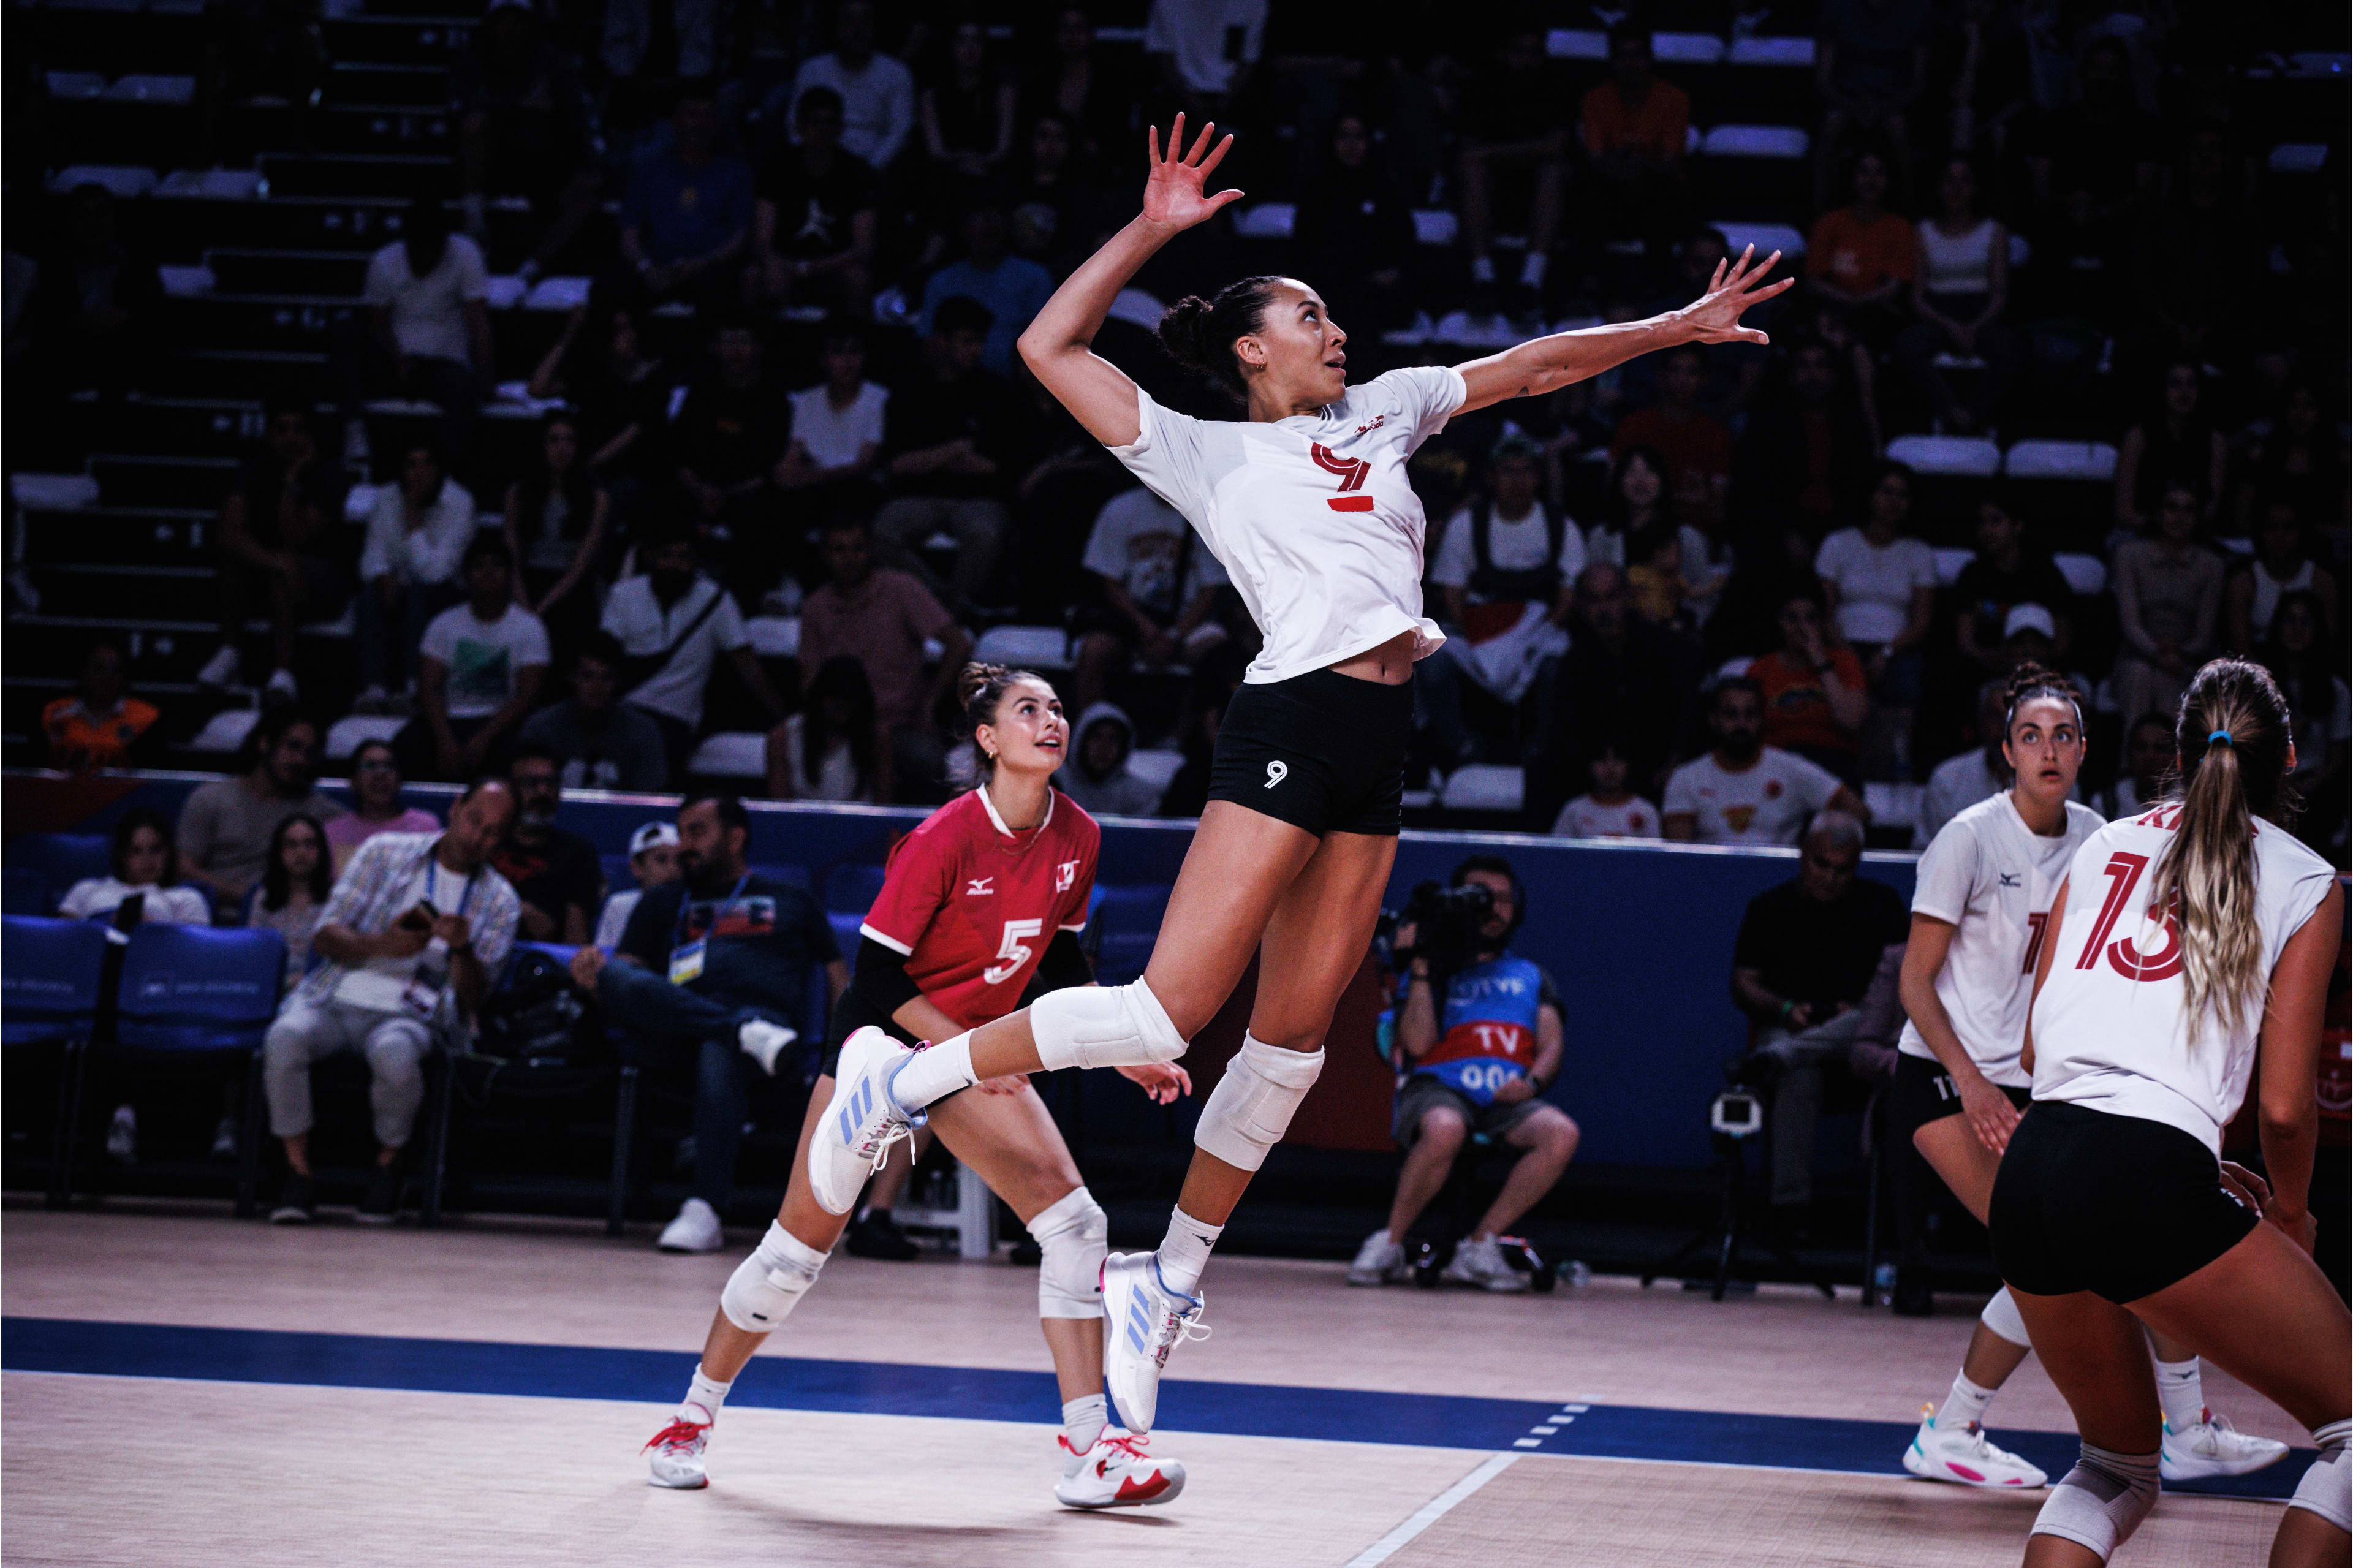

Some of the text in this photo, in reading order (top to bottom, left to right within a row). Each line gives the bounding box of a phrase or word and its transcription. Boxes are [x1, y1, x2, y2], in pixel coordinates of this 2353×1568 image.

[1311, 442, 1371, 492] 9
[1263, 760, 1288, 789] 9
[983, 918, 1043, 985] 5
[1474, 1026, 1519, 1056] TV
